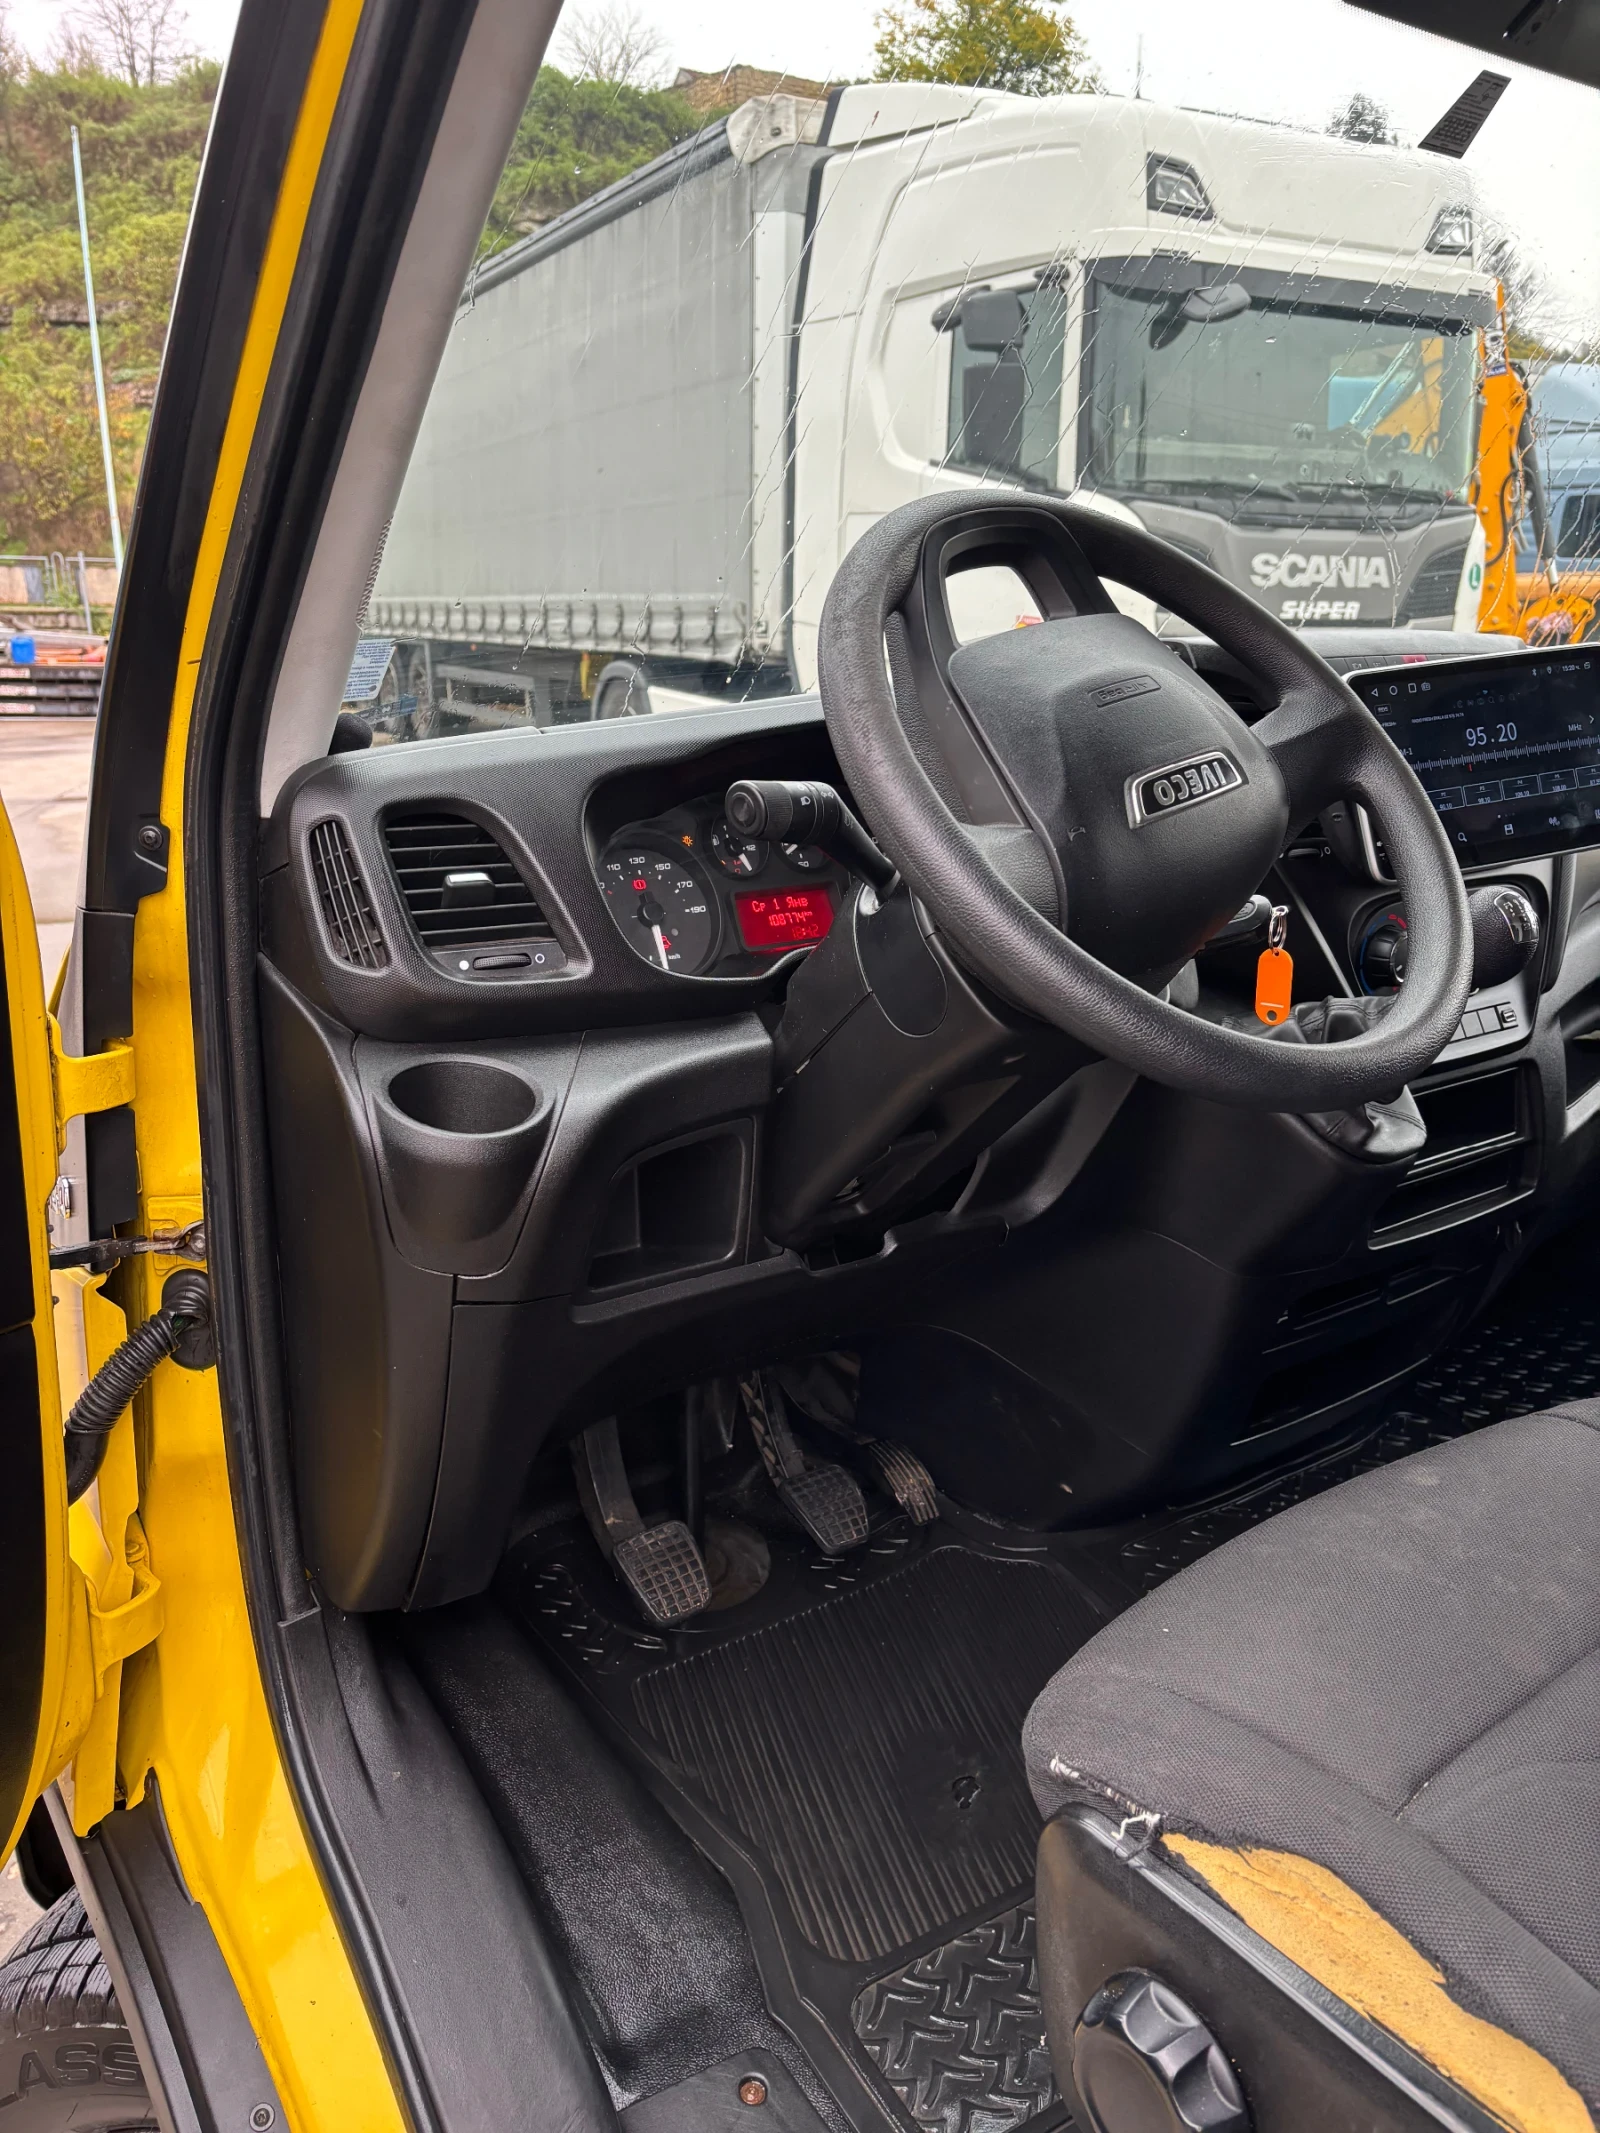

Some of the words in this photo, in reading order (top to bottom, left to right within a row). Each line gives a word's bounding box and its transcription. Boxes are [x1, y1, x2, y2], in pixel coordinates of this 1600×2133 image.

[1250, 552, 1390, 588] SCANIA
[1279, 600, 1360, 620] SUPER
[1568, 723, 1582, 732] MHz
[1466, 722, 1518, 747] 95.20
[1400, 747, 1413, 756] M-1
[1153, 761, 1226, 806] IVECO
[628, 856, 645, 864] 130
[606, 863, 621, 871] 110
[654, 863, 671, 871] 150
[677, 880, 693, 889] 170
[773, 898, 780, 910] 1
[690, 905, 706, 913] 190
